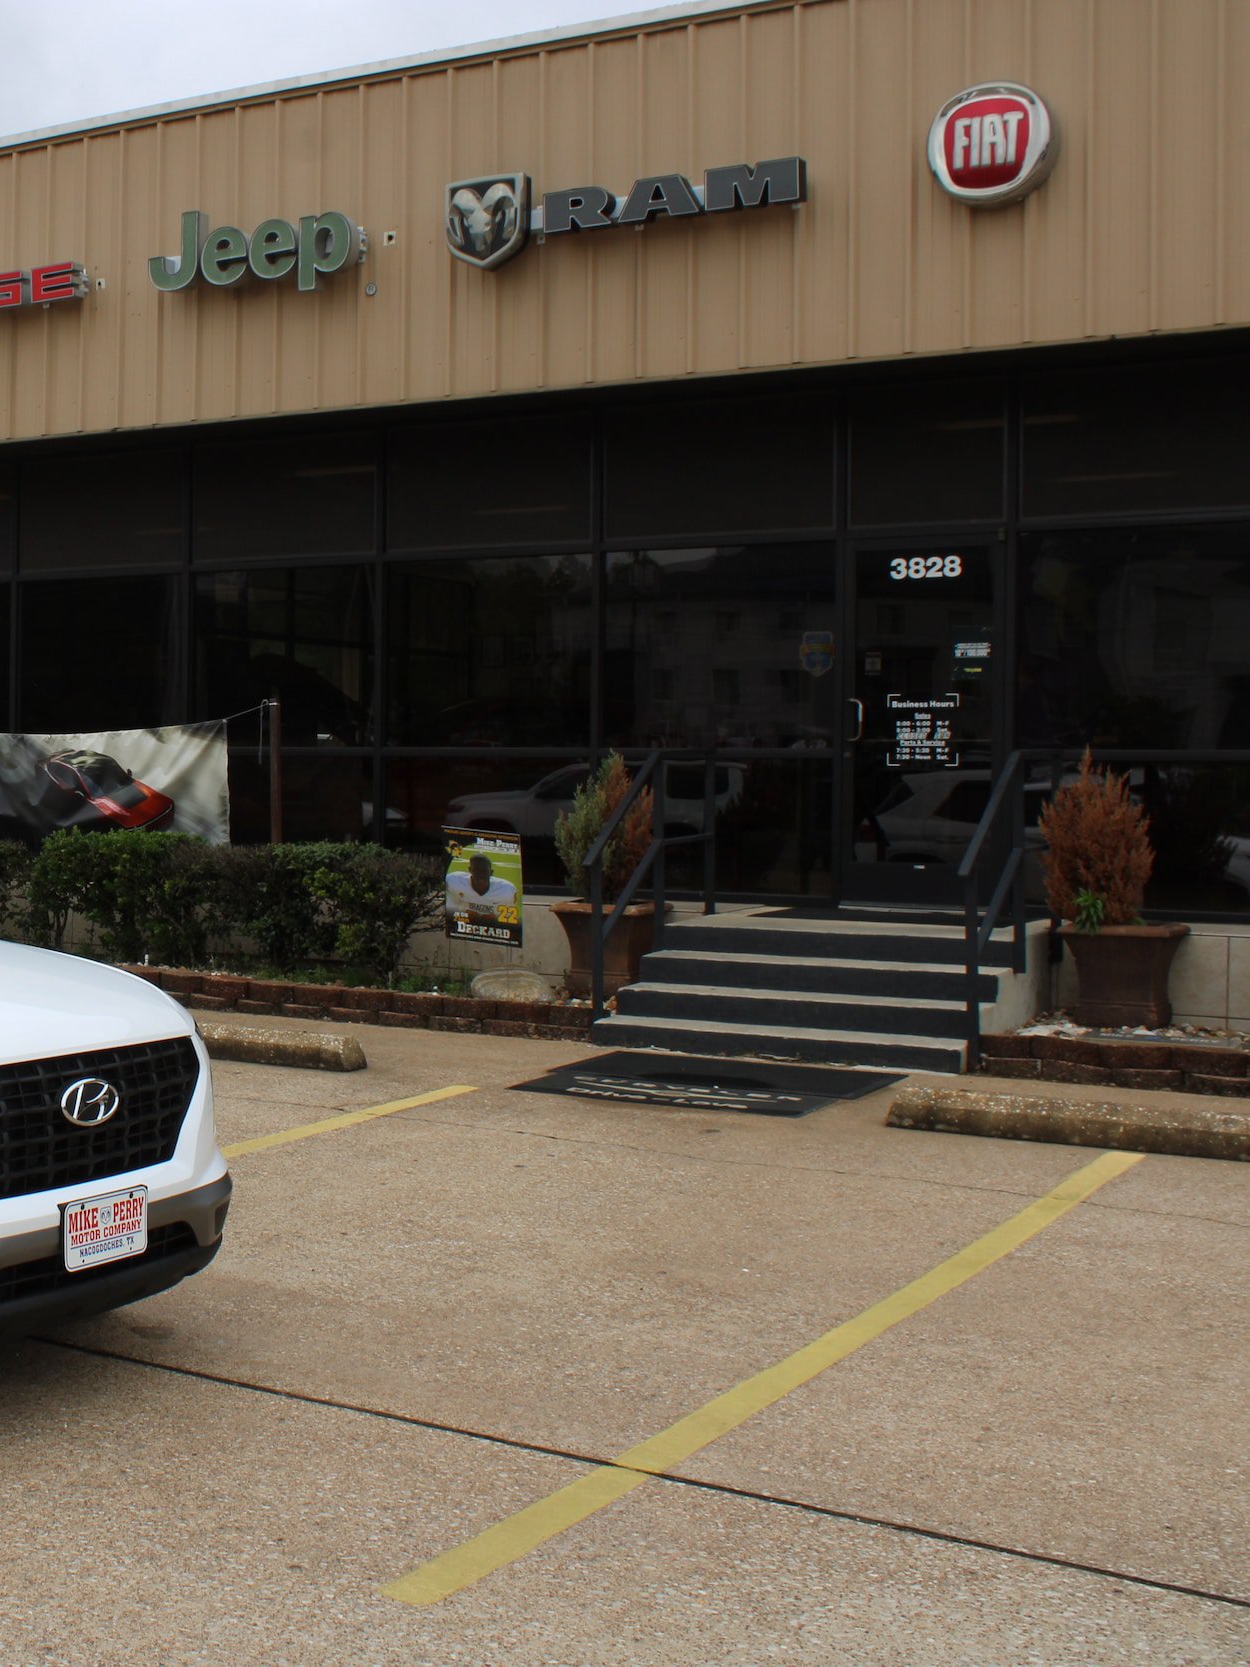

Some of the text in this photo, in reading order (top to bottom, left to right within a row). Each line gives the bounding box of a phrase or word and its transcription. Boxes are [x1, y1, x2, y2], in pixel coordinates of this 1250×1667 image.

[952, 111, 1025, 170] FIAT
[542, 156, 803, 234] RAM
[148, 210, 353, 292] Jeep
[890, 555, 962, 580] 3828
[891, 700, 954, 708] Business Hours
[497, 904, 519, 925] 22
[456, 921, 511, 939] DECKARD
[68, 1196, 144, 1234] MIKE PERRY
[71, 1218, 142, 1246] MOTOR COMPANY
[126, 1235, 135, 1245] TX
